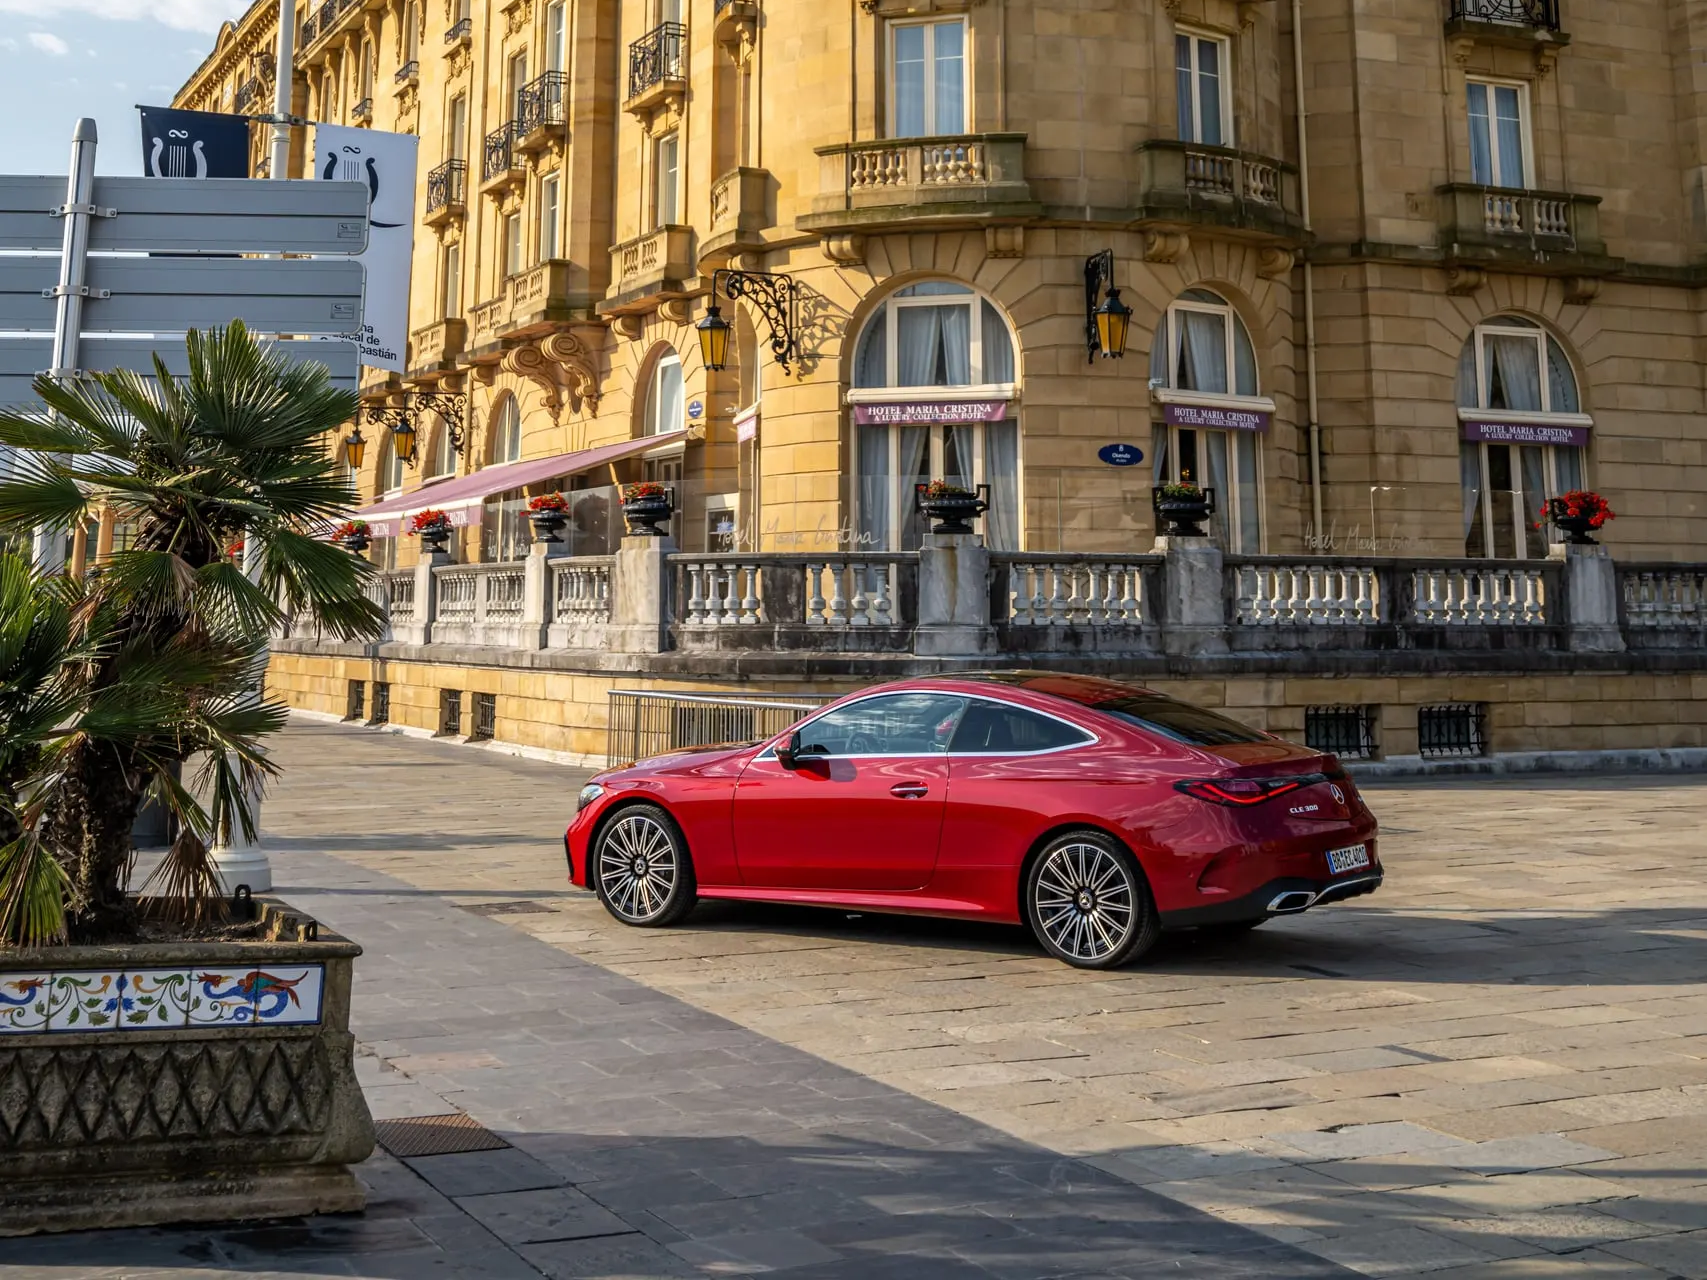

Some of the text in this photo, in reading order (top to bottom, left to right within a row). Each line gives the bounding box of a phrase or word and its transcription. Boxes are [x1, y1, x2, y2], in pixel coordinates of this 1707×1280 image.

[367, 335, 380, 345] de
[360, 344, 397, 360] bastián
[868, 404, 991, 416] HOTEL MARIA CRISTINA
[1174, 407, 1259, 423] HOTEL MARIA CRISTINA
[882, 413, 910, 421] LUXURY
[913, 413, 958, 421] COLLECTION
[1206, 419, 1238, 427] COLLECTION
[1480, 424, 1573, 438] HOTEL MARIA CRISTINA
[1304, 519, 1339, 550] Hotel
[1289, 804, 1319, 814] CLE 300
